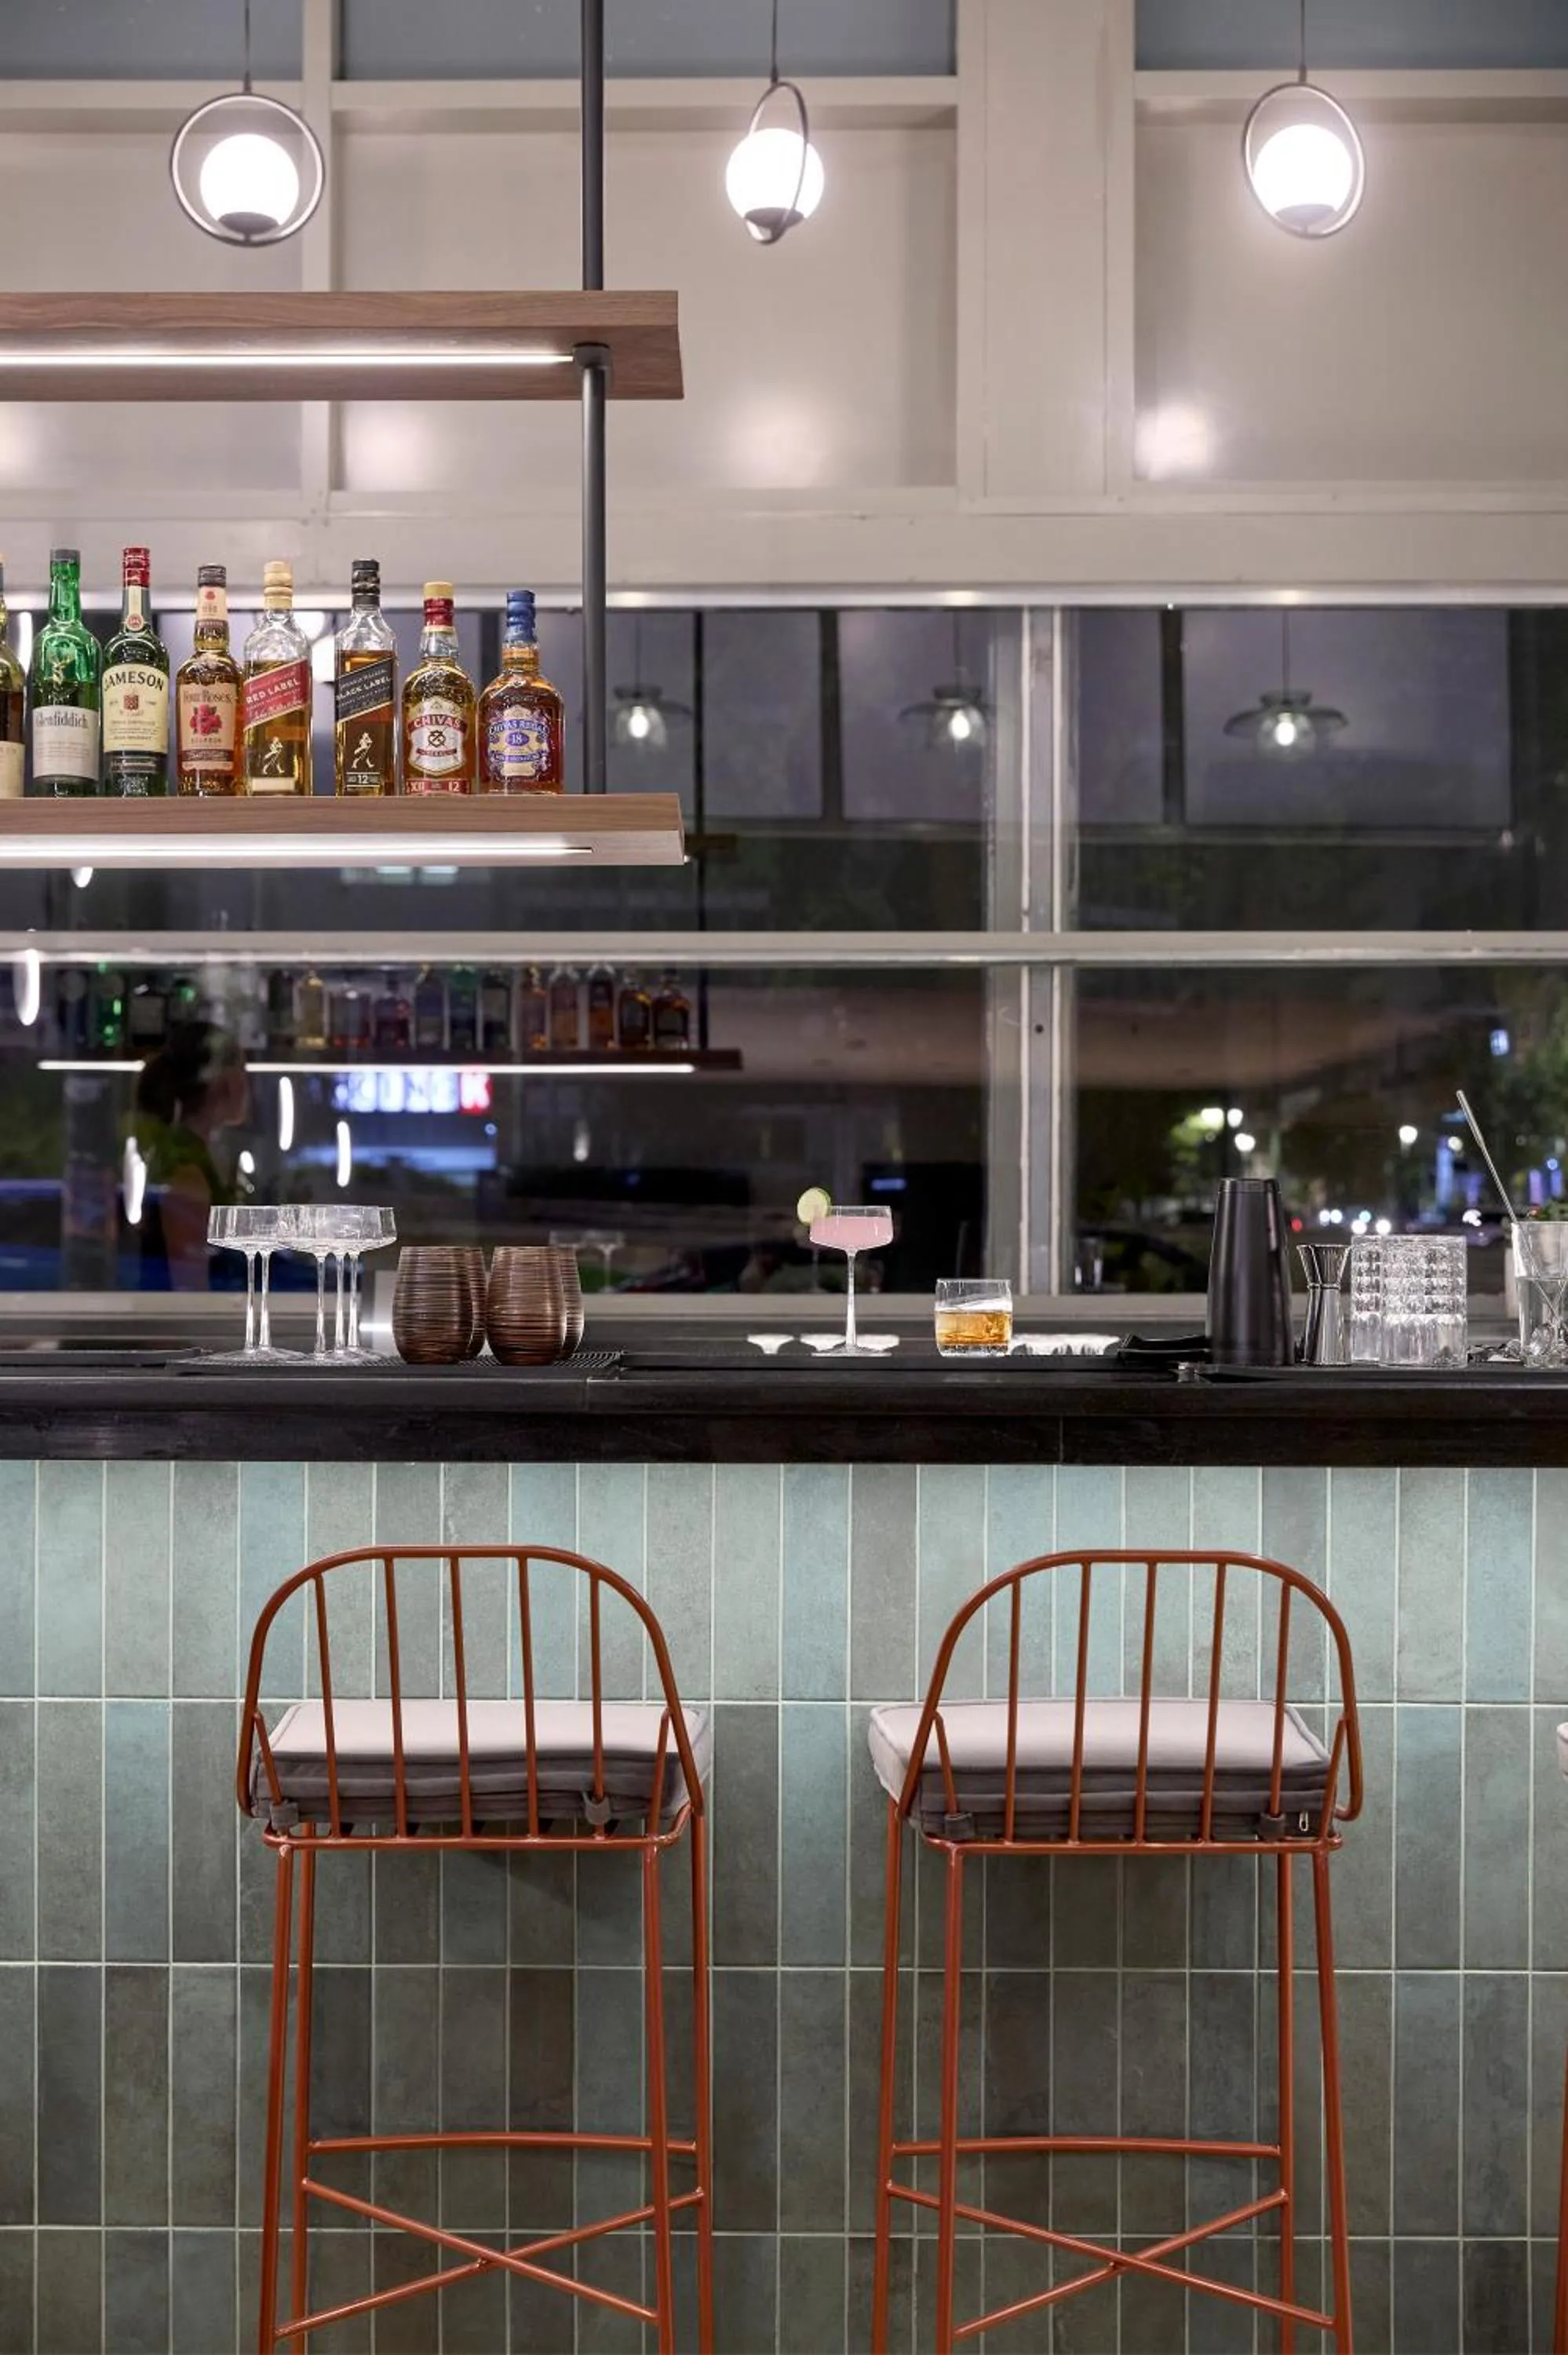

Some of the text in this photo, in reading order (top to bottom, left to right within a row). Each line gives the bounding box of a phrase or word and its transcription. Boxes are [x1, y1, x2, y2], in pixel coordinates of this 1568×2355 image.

[103, 671, 164, 692] JAMESON
[364, 676, 391, 690] LABEL
[246, 690, 266, 704] RED
[268, 677, 301, 696] LABEL
[414, 714, 461, 728] CHIVAS
[511, 734, 523, 745] 18
[357, 775, 368, 784] 12
[448, 781, 460, 792] 12
